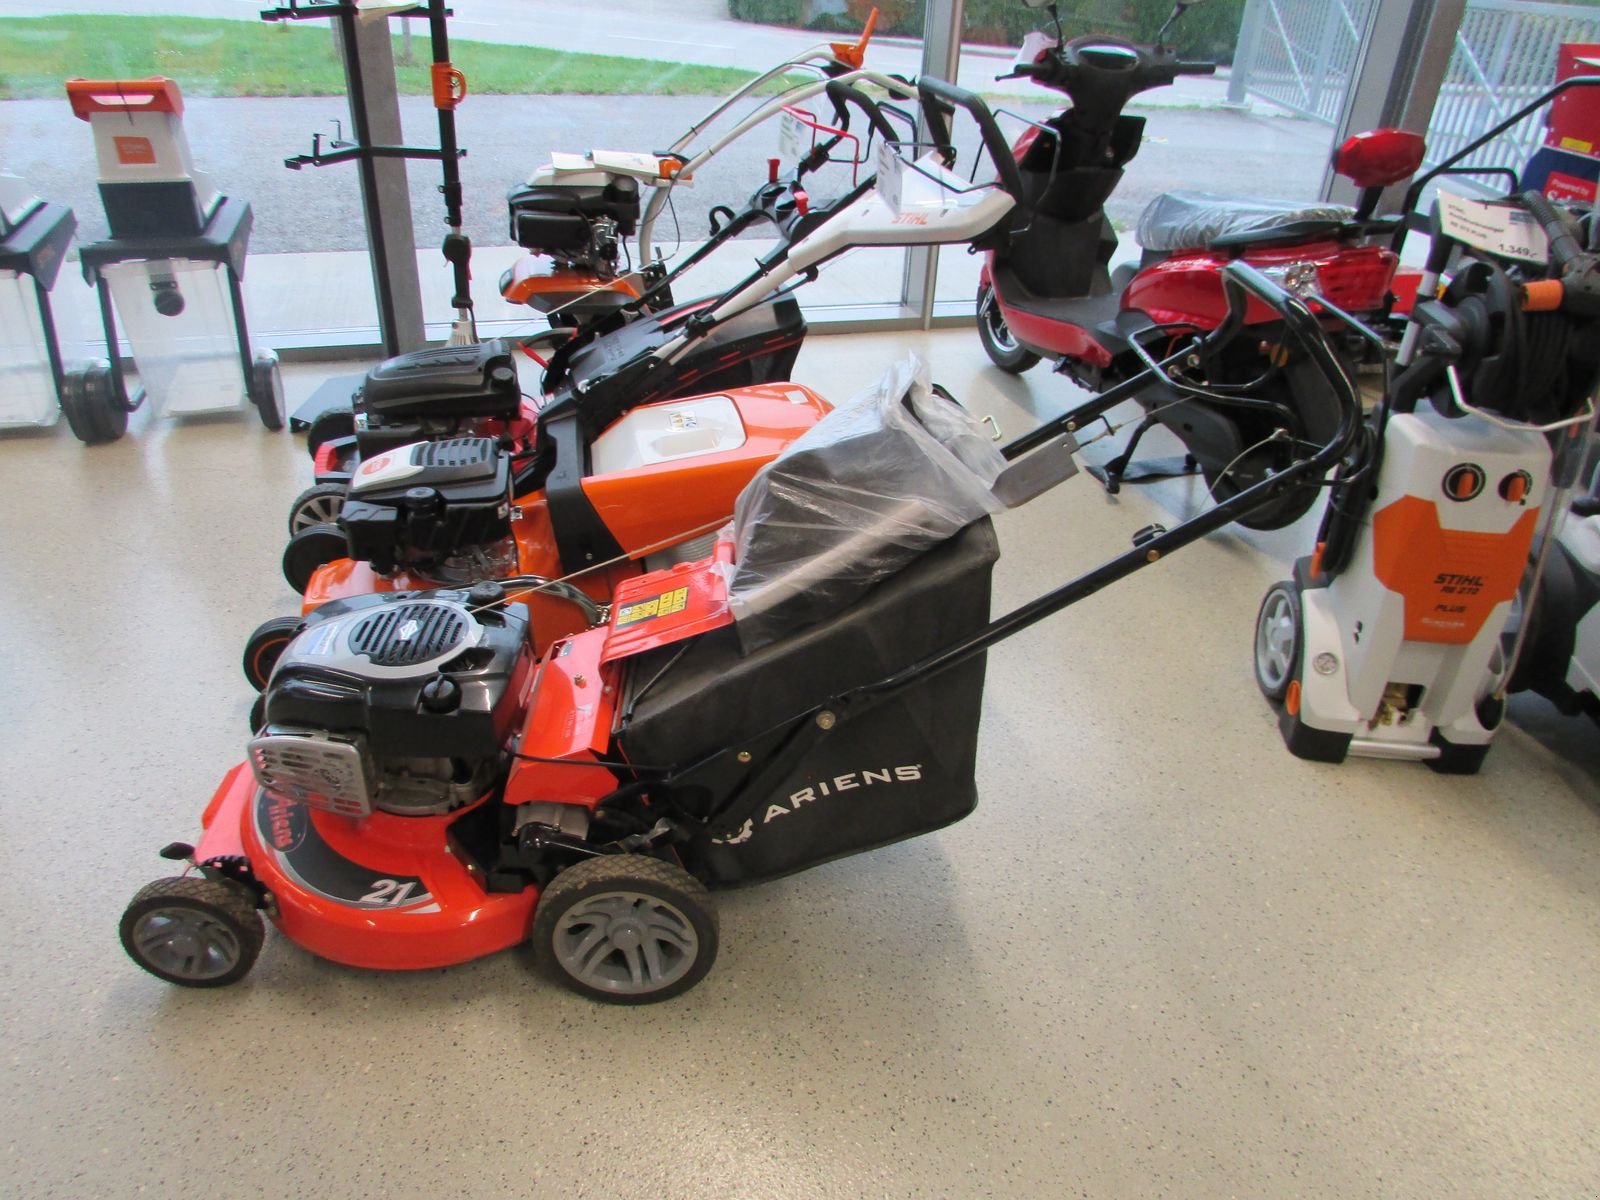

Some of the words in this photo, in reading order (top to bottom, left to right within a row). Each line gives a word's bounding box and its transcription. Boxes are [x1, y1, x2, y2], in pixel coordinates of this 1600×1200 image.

[891, 212, 928, 225] STIHL
[1433, 573, 1483, 587] STIHL
[1434, 604, 1468, 613] PLUS
[763, 764, 922, 824] ARIENS
[358, 878, 417, 906] 21
